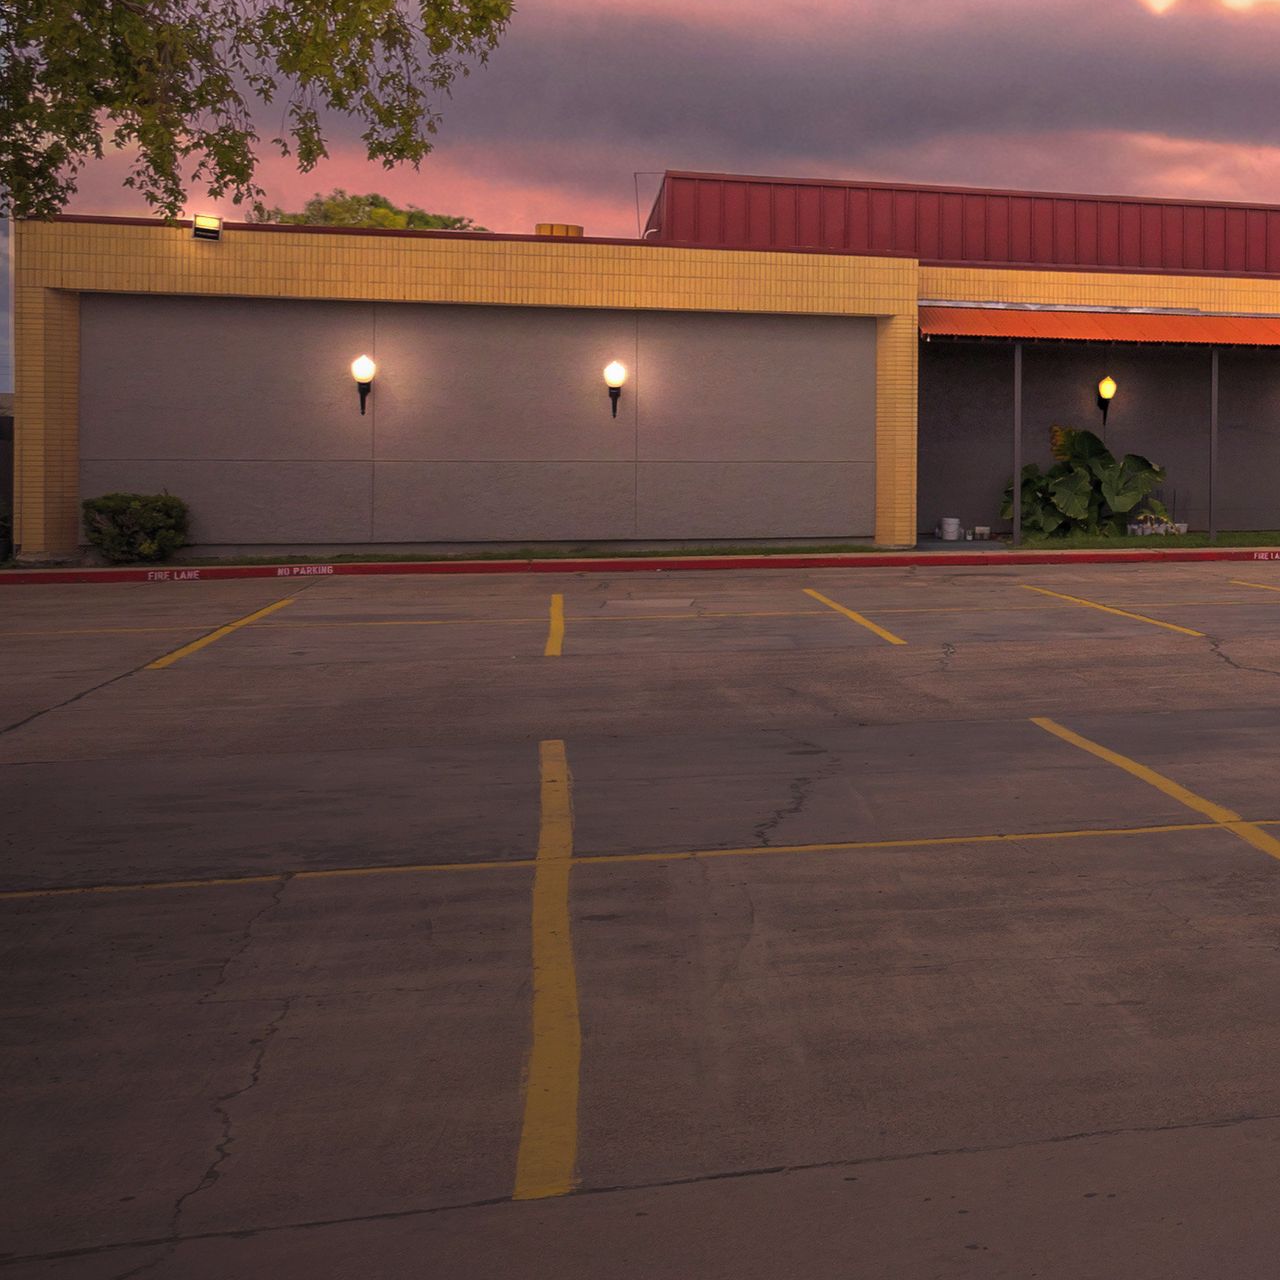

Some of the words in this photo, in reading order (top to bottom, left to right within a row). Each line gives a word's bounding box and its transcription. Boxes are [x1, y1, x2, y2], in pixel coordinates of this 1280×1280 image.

[1253, 552, 1270, 561] FIRE
[147, 571, 171, 581] FIRE
[173, 570, 201, 581] LANE
[277, 567, 290, 577] NO
[292, 565, 334, 576] PARKING
